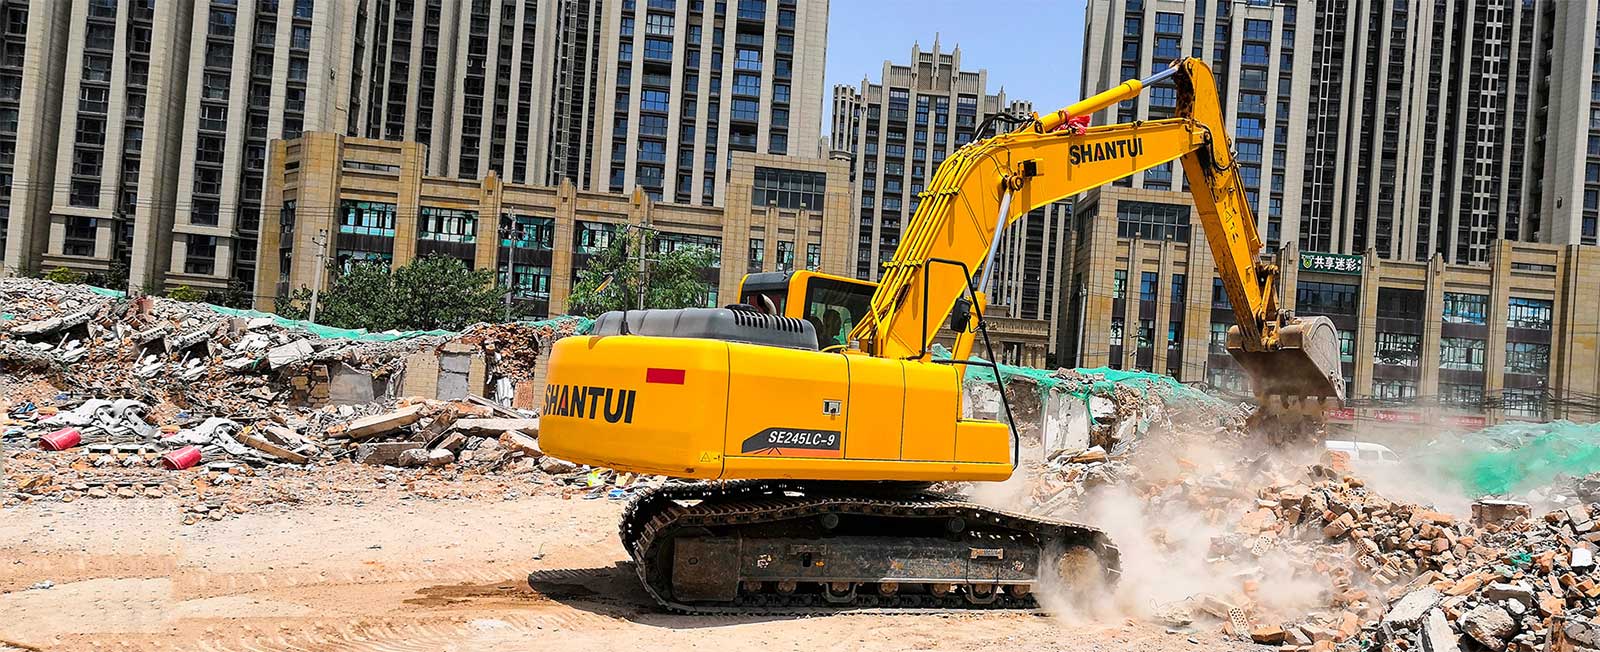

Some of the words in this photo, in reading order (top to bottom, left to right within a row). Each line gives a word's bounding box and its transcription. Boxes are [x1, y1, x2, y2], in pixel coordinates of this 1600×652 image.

[1070, 138, 1143, 165] SHANTUI
[543, 384, 636, 423] SHANTUI
[768, 431, 835, 446] SE245LC-9
